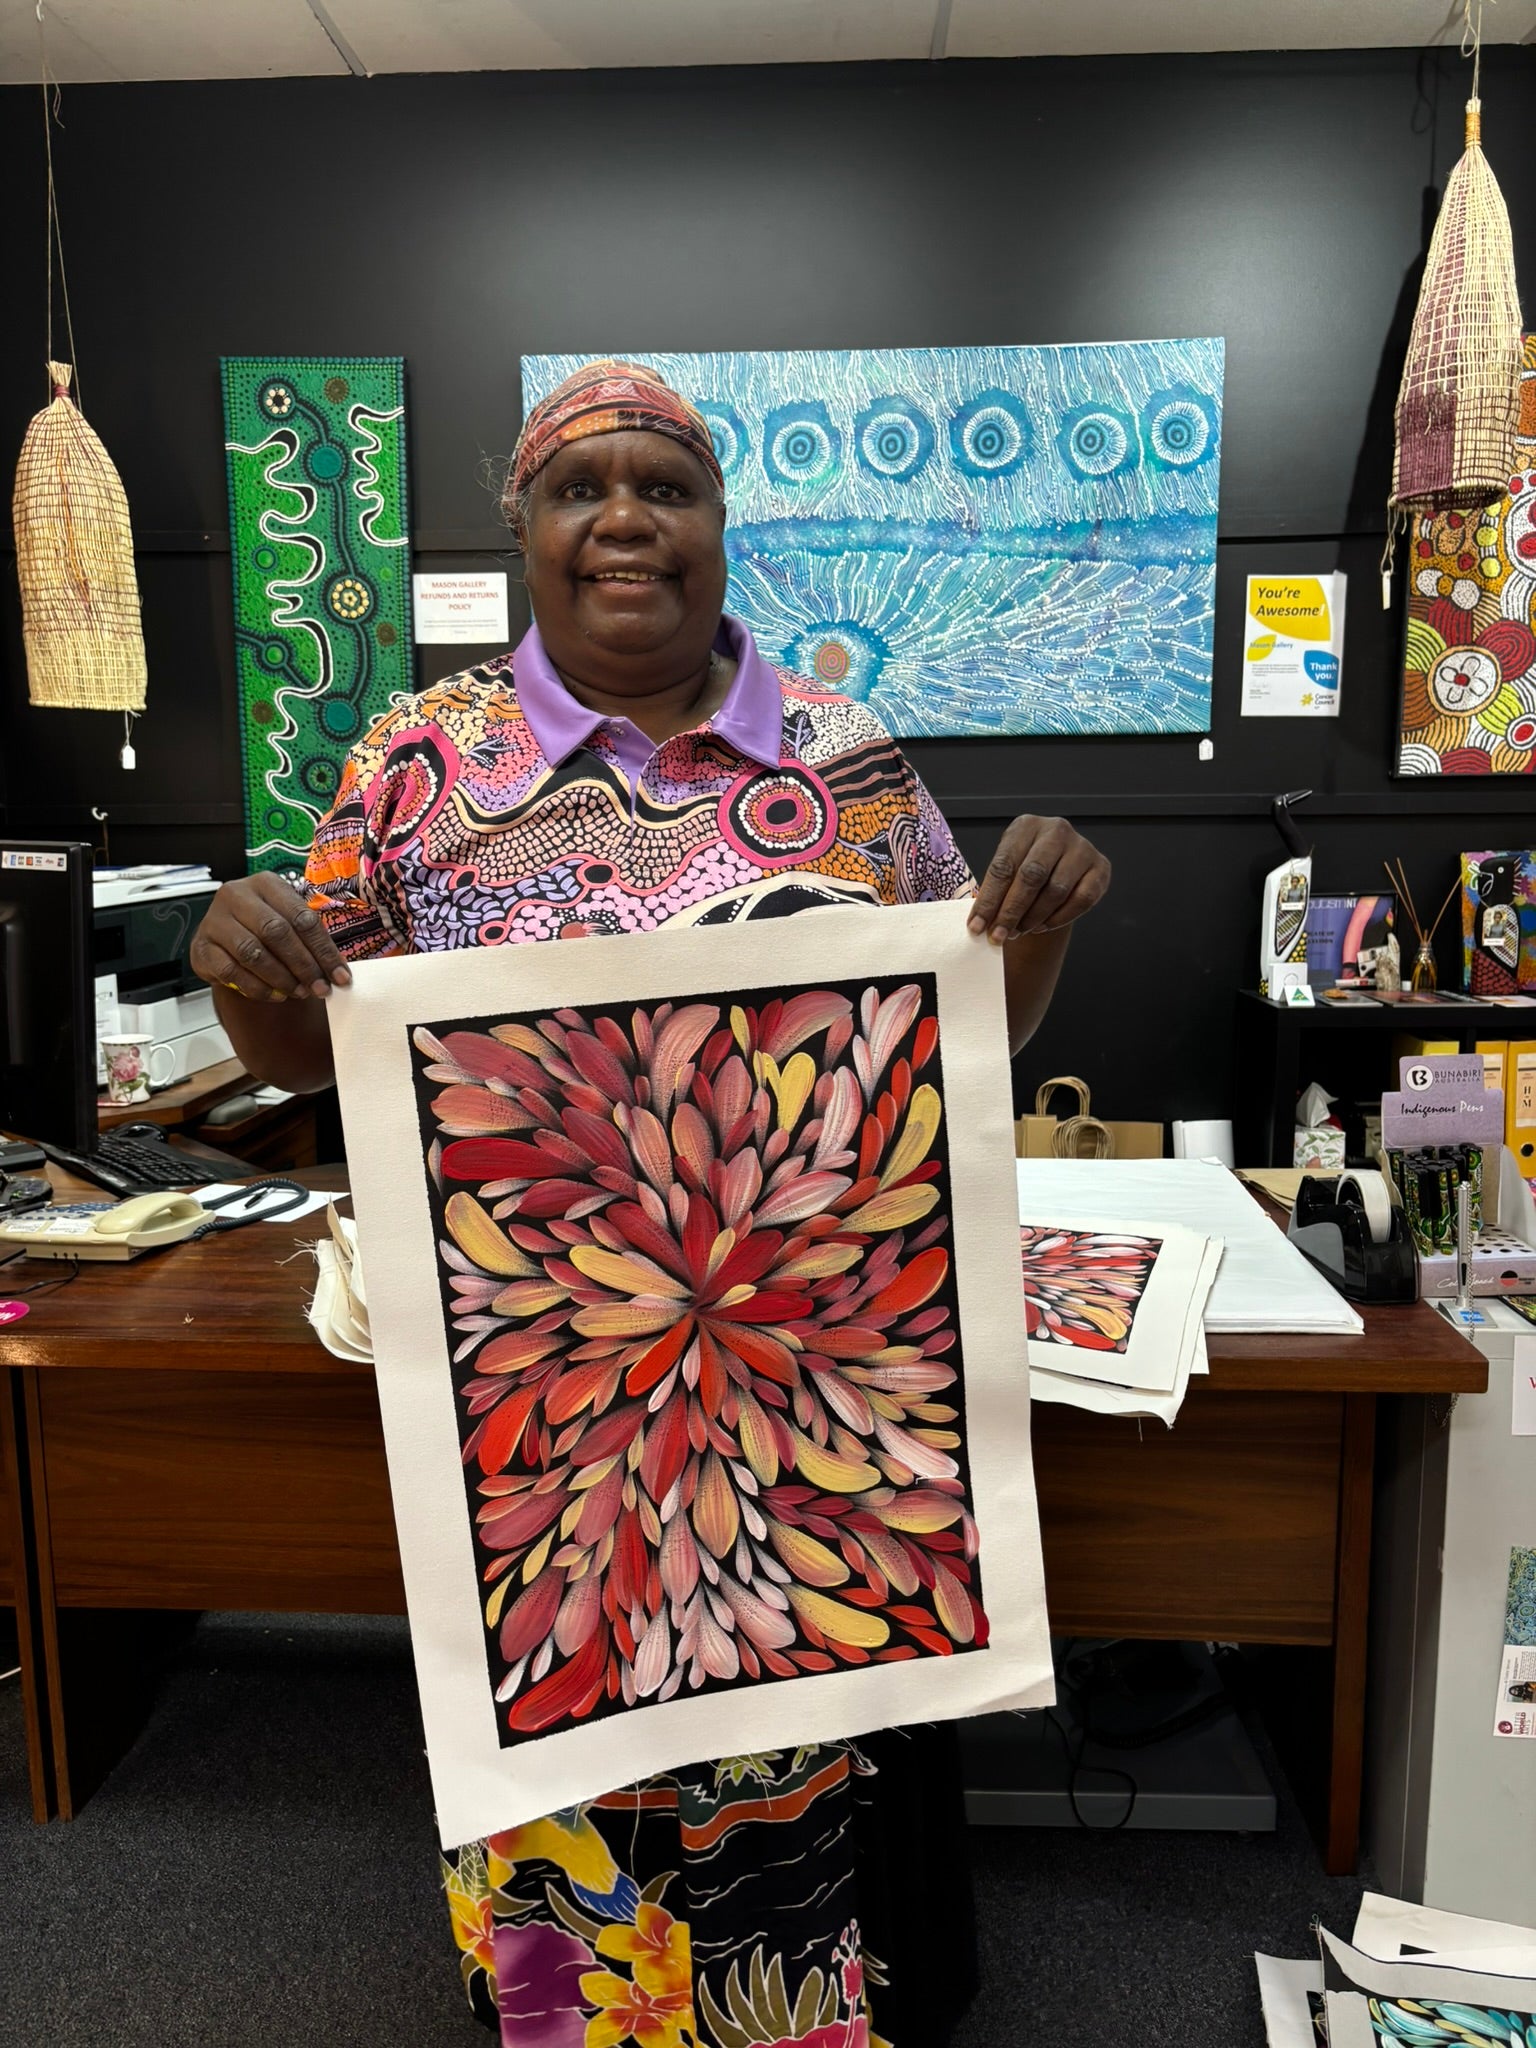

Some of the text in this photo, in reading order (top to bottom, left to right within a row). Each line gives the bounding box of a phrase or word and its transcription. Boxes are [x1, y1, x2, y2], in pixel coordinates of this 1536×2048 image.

[1256, 603, 1326, 616] Awesome!
[1272, 642, 1293, 650] Gallery
[1309, 662, 1337, 671] Thank
[1314, 672, 1334, 681] you.
[1434, 1069, 1481, 1079] BUNABIRI
[1401, 1100, 1484, 1118] Indigenous Pens
